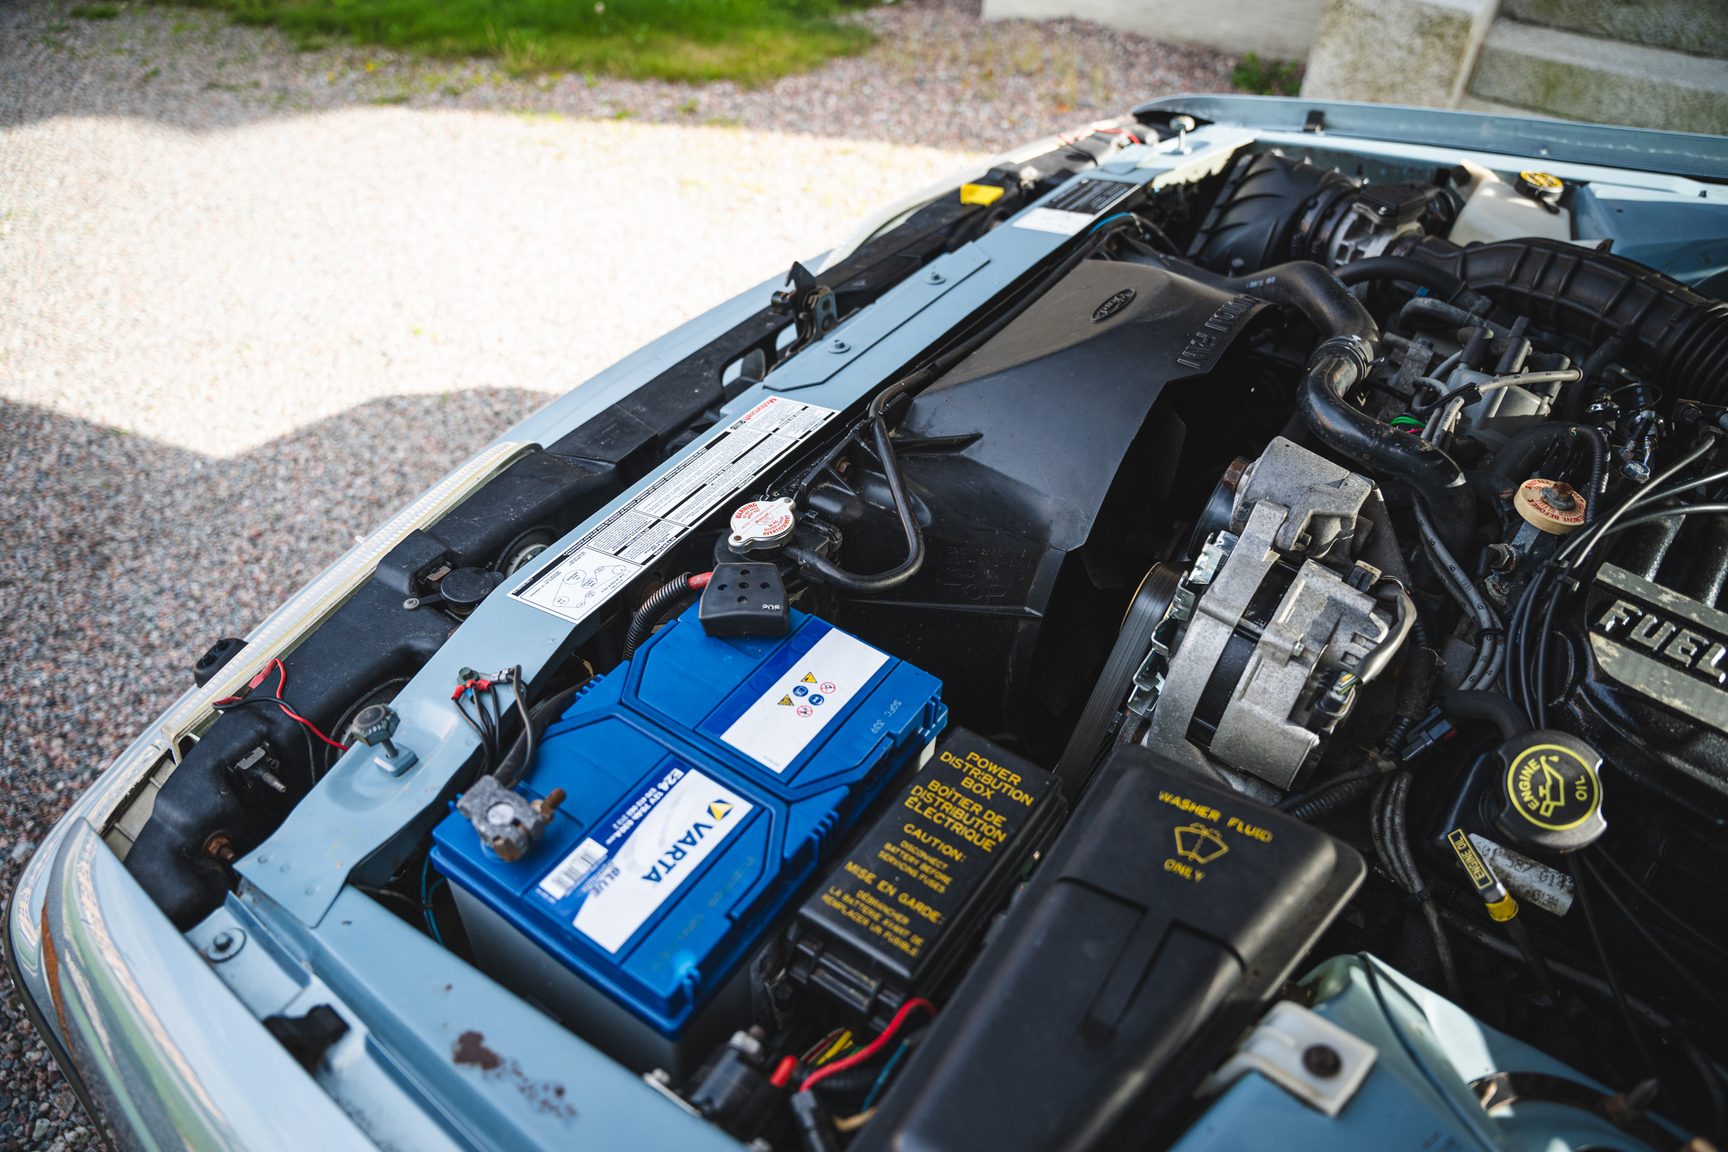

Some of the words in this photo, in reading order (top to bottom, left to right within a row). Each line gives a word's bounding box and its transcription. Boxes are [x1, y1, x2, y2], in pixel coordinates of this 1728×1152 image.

[735, 503, 757, 519] WARNING
[1531, 502, 1560, 520] BEFORE
[943, 583, 1006, 602] TOP
[1599, 599, 1727, 684] FUEL
[656, 767, 685, 792] E24
[939, 751, 1034, 807] DISTRIBUTION
[960, 776, 995, 800] BOX
[966, 751, 1022, 786] POWER
[1518, 758, 1541, 811] ENGINE
[1574, 775, 1588, 801] OIL
[904, 795, 997, 853] ÉLECTRIQUE
[910, 785, 1007, 843] DISTRIBUTION
[927, 779, 984, 817] BOÎTIER
[983, 808, 1006, 829] DE
[1158, 790, 1222, 822] WASHER
[1227, 817, 1273, 843] FLUID
[641, 822, 714, 883] VARTA
[899, 840, 949, 871] DISCONNECT
[903, 823, 967, 863] CAUTION:
[1455, 836, 1467, 850] OIL
[590, 866, 621, 897] BLUE
[877, 851, 919, 878] SERVICING
[917, 871, 947, 895] FUSES
[883, 842, 919, 869] BATTERY
[917, 858, 953, 887] BEFORE
[1164, 858, 1206, 883] ONLY
[1461, 850, 1485, 880] ENGINE
[843, 860, 877, 885] MISE
[876, 879, 897, 897] EN
[896, 891, 947, 926] GARDE:
[855, 889, 910, 925] DÉBRANCHER
[821, 893, 869, 926] REMPLACER
[869, 921, 882, 936] UN
[881, 931, 920, 957] FUSIBLE
[828, 885, 841, 898] LA
[842, 892, 882, 920] BATTERIE
[881, 916, 911, 938] AVANT
[909, 930, 924, 949] DE
